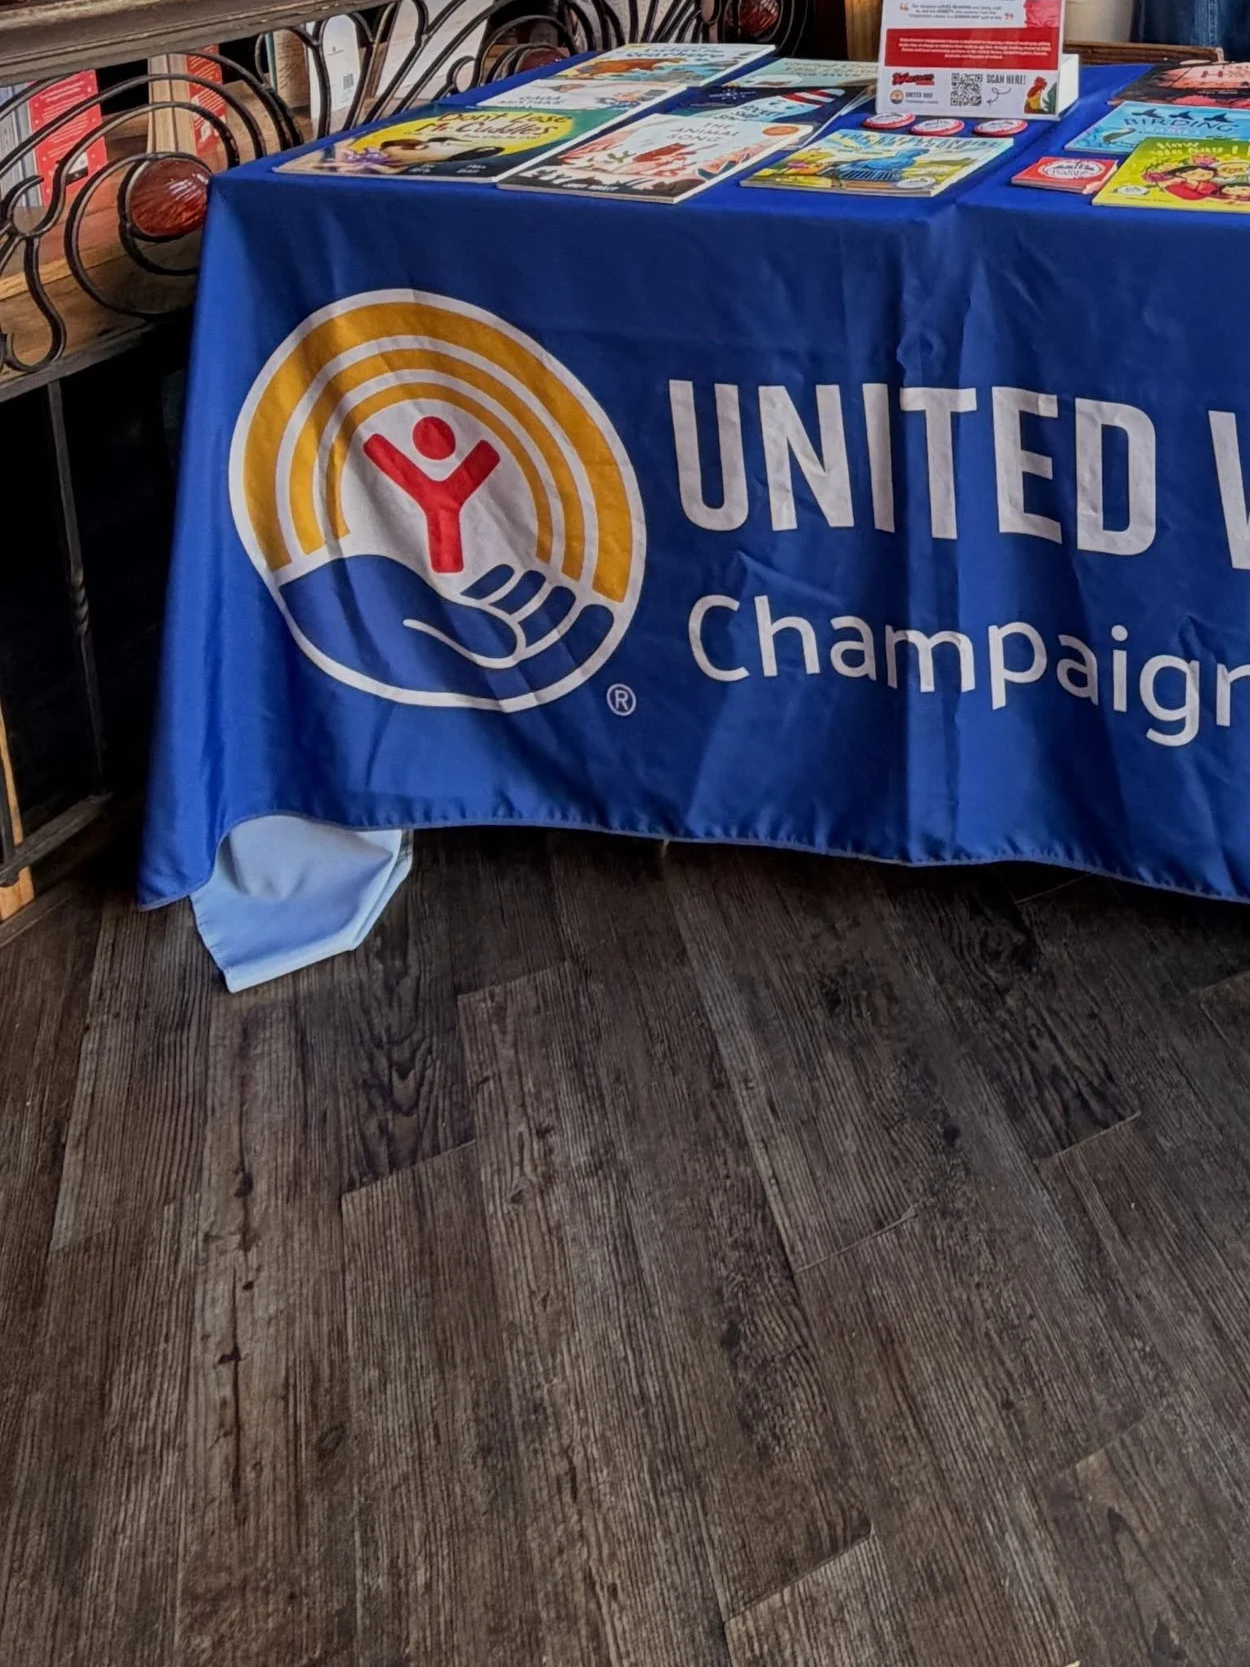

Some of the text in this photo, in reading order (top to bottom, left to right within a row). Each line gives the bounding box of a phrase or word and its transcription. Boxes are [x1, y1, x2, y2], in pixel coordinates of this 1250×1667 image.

[985, 73, 1027, 85] SCAN HERE!
[437, 112, 573, 124] Don't Lose
[455, 121, 559, 135] Cuddles
[1123, 117, 1240, 134] BIRDING
[666, 134, 721, 142] SONG
[669, 127, 740, 137] ANIMAL
[1156, 141, 1200, 150] How
[1231, 145, 1239, 154] I
[668, 378, 1157, 556] UNITED
